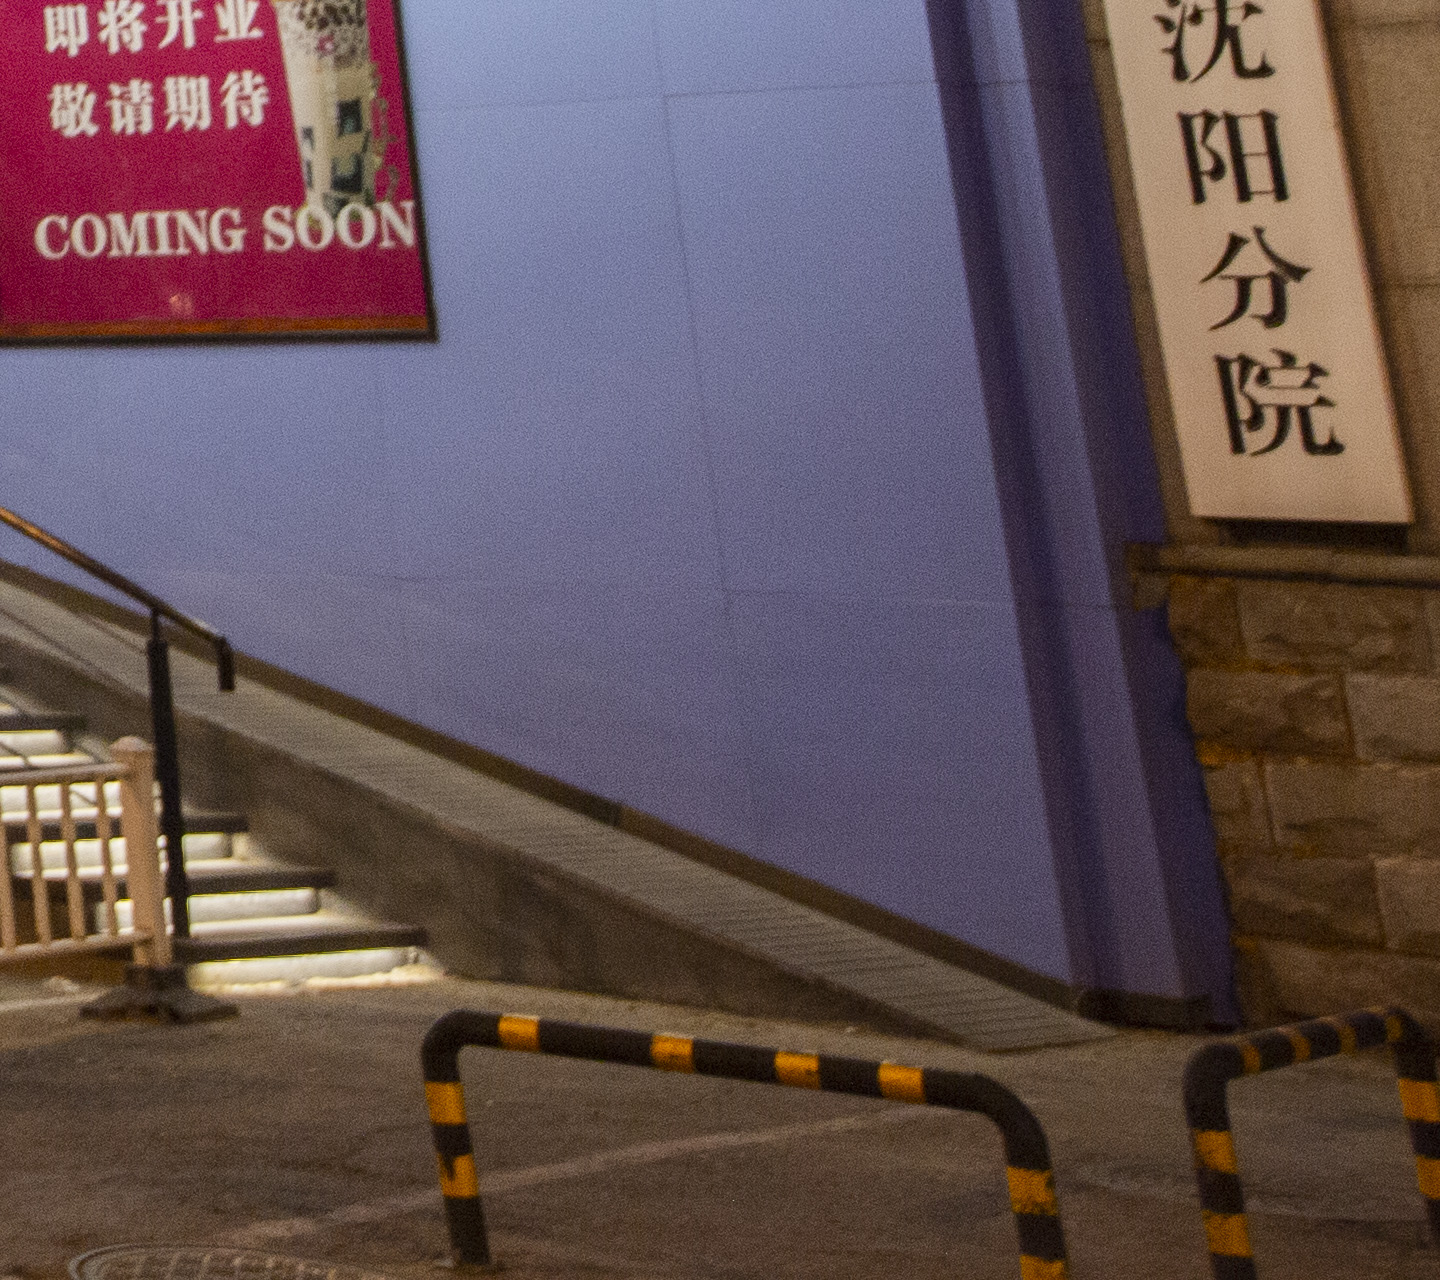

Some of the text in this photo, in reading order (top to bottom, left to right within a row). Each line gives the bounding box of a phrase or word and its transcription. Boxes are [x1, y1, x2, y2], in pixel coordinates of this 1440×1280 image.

[48, 70, 270, 138] 敬请期待
[34, 200, 416, 260] COMING SOON
